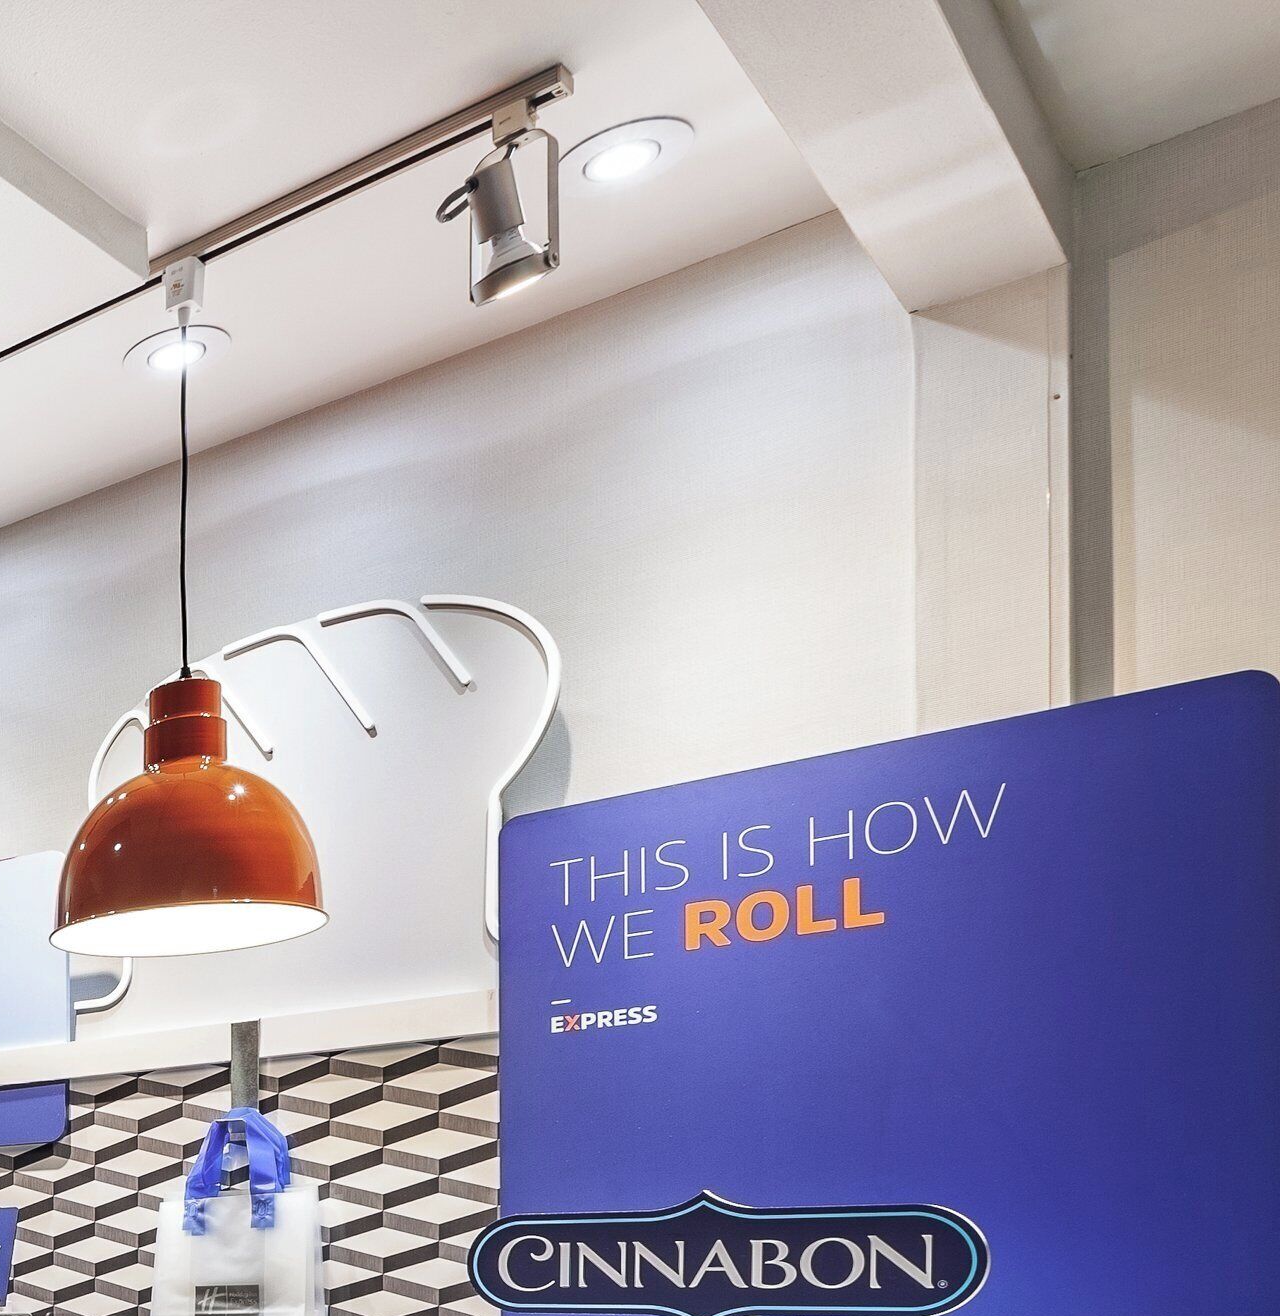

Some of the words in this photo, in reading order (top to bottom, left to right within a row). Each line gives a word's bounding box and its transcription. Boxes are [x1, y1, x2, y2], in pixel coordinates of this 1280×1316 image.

[549, 839, 690, 906] THIS
[722, 824, 775, 880] IS
[809, 782, 1007, 867] HOW
[551, 909, 654, 968] WE
[684, 877, 885, 952] ROLL
[550, 1005, 658, 1034] EXPRESS
[497, 1233, 935, 1292] CINNABON
